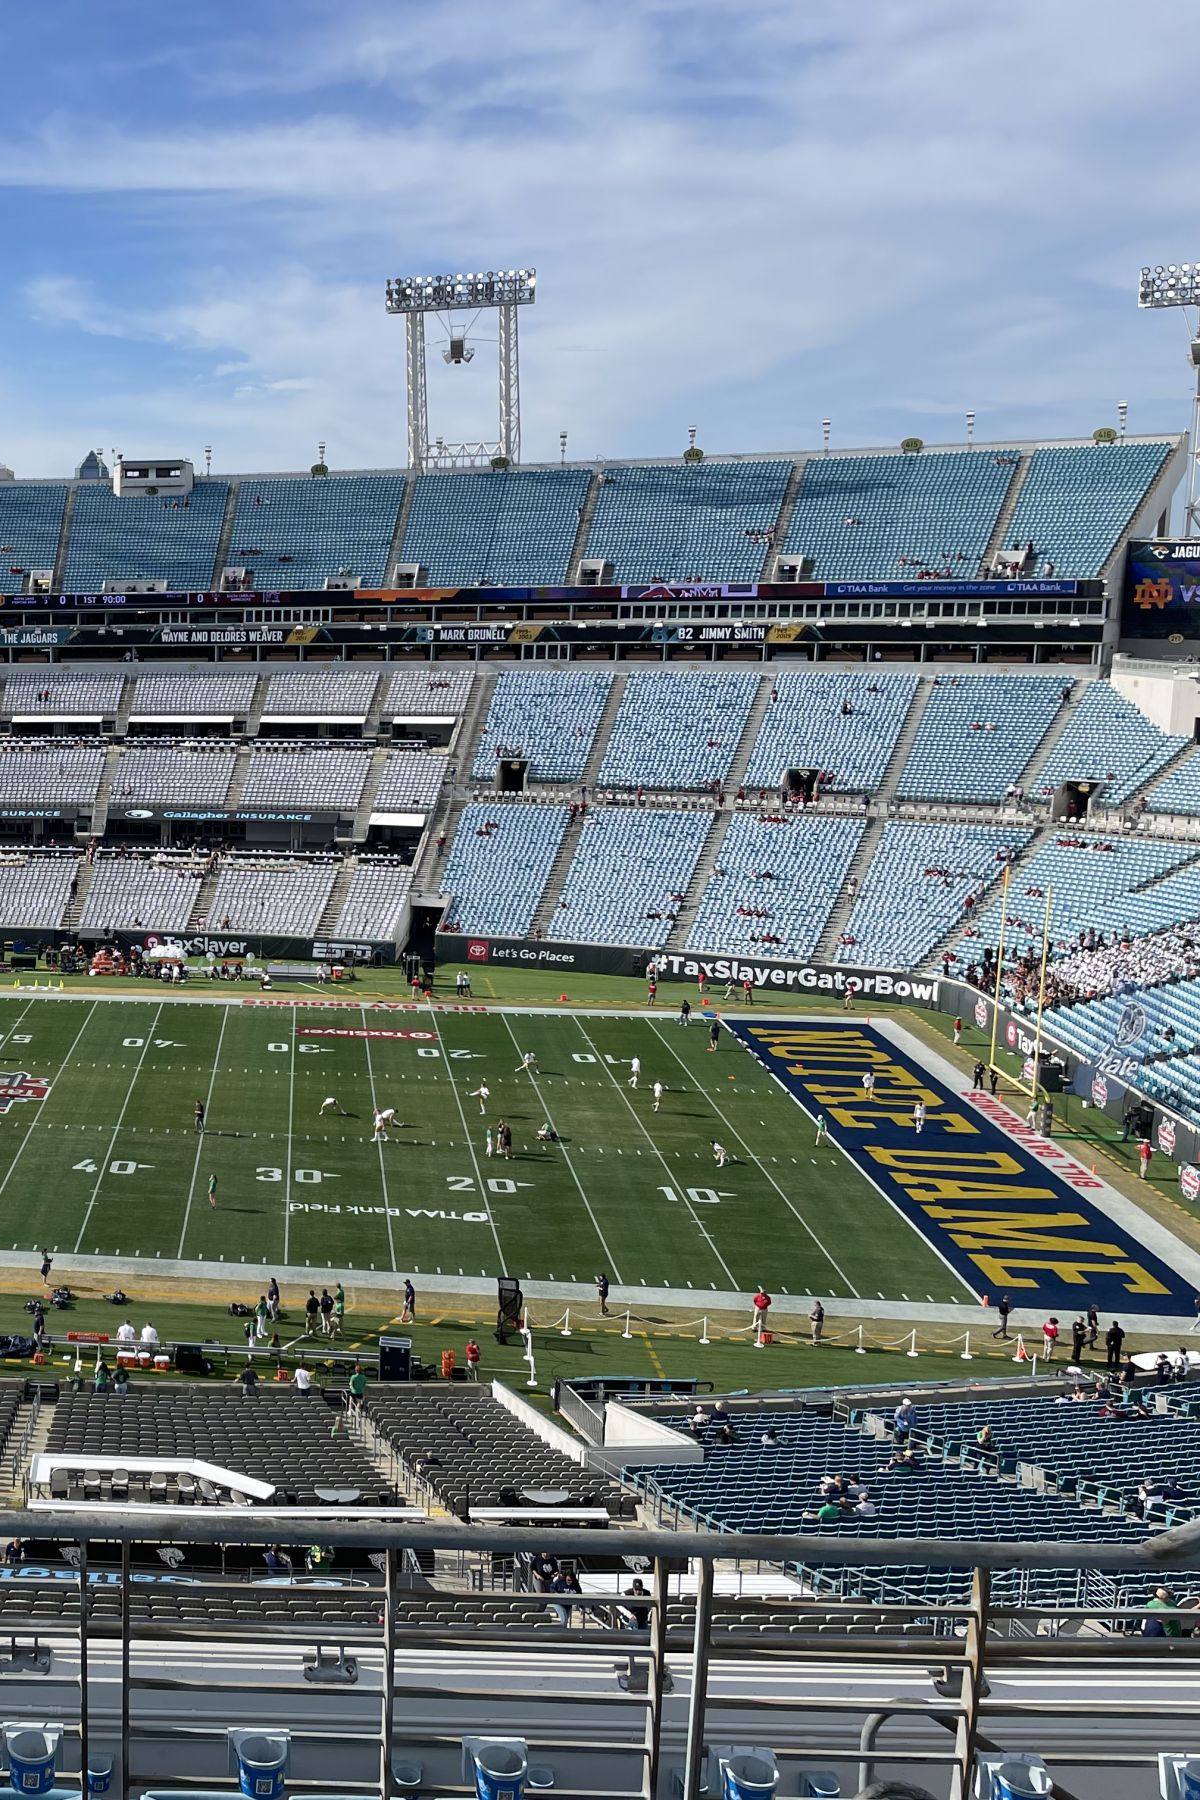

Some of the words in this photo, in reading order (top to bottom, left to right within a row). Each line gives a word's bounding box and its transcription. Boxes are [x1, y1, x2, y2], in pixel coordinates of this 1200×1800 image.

[1017, 583, 1038, 591] TIAA
[1039, 583, 1061, 591] Bank
[83, 596, 96, 604] 1ST
[102, 595, 126, 604] 90:00
[4, 633, 18, 644] THE
[20, 632, 58, 644] JAGUARS
[161, 631, 189, 643] WAYNE
[191, 631, 208, 642] AND
[211, 631, 246, 642] DELORES
[249, 630, 283, 642] WEAVER
[440, 630, 465, 641] MARK
[468, 629, 506, 641] BRUNELL
[678, 628, 693, 639] 82
[700, 628, 731, 639] JIMMY
[734, 628, 765, 639] SMITH
[163, 810, 230, 821] Gallagher
[235, 813, 312, 821] INSURANCE
[492, 948, 518, 958] Let's
[519, 949, 537, 960] Go
[538, 951, 575, 963] Places
[242, 999, 362, 1008] GROUNDS
[369, 1002, 418, 1010] GAY
[302, 1027, 407, 1039] TaxSlayer
[122, 1037, 175, 1048] 40
[267, 1043, 321, 1053] 30
[417, 1048, 472, 1059] 20
[571, 1053, 622, 1064] 10
[747, 1027, 982, 1134] NOTRE
[960, 1091, 1034, 1136] GROUNDS
[1022, 1137, 1065, 1159] GAY
[72, 1159, 138, 1174] 40
[255, 1167, 322, 1184] 30
[1052, 1162, 1104, 1189] BILL
[446, 1176, 518, 1193] 20
[656, 1186, 721, 1203] 10
[289, 1202, 341, 1213] Field
[347, 1205, 400, 1217] Bank
[404, 1208, 462, 1220] TIAA
[863, 1145, 1173, 1295] DAME
